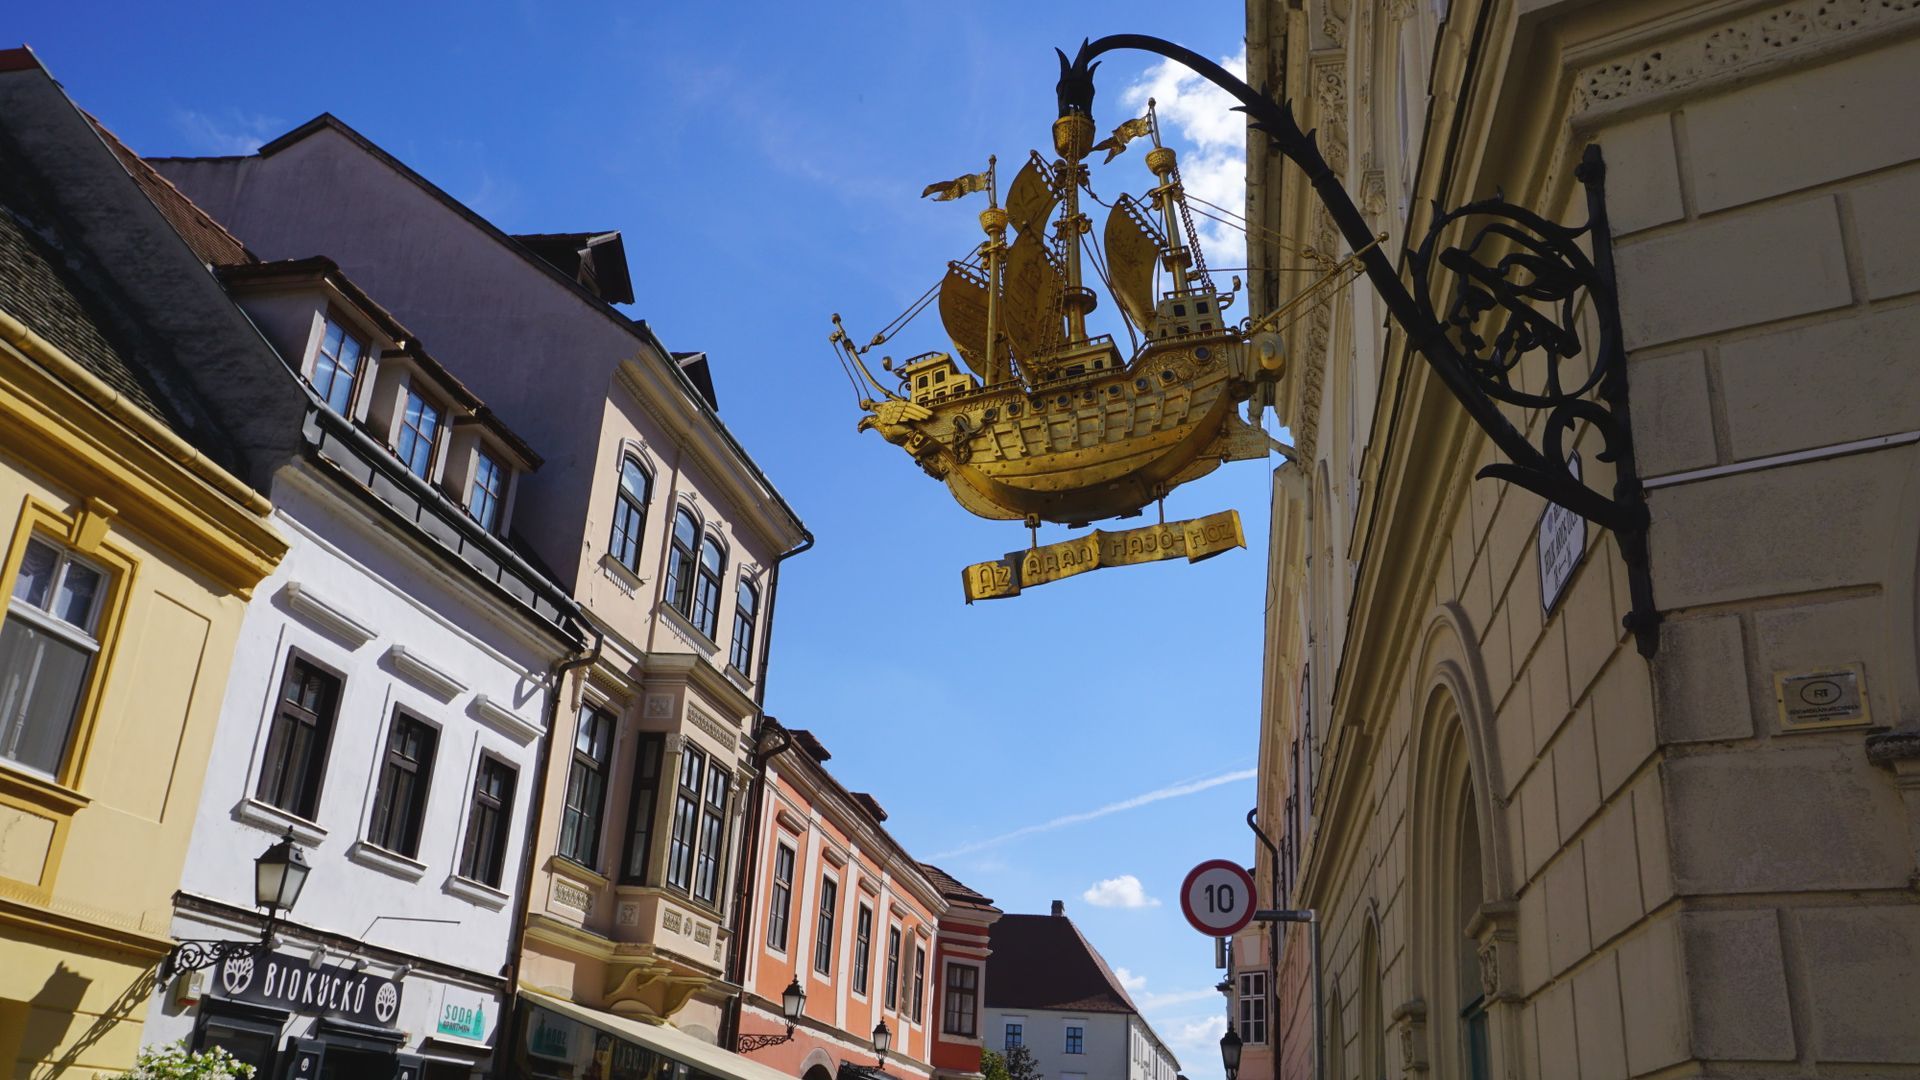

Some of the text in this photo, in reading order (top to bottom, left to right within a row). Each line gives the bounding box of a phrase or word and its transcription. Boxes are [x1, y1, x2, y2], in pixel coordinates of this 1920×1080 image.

[1205, 884, 1234, 914] 10
[263, 962, 368, 1014] BIOKUCKÓ
[444, 1003, 473, 1025] SODA
